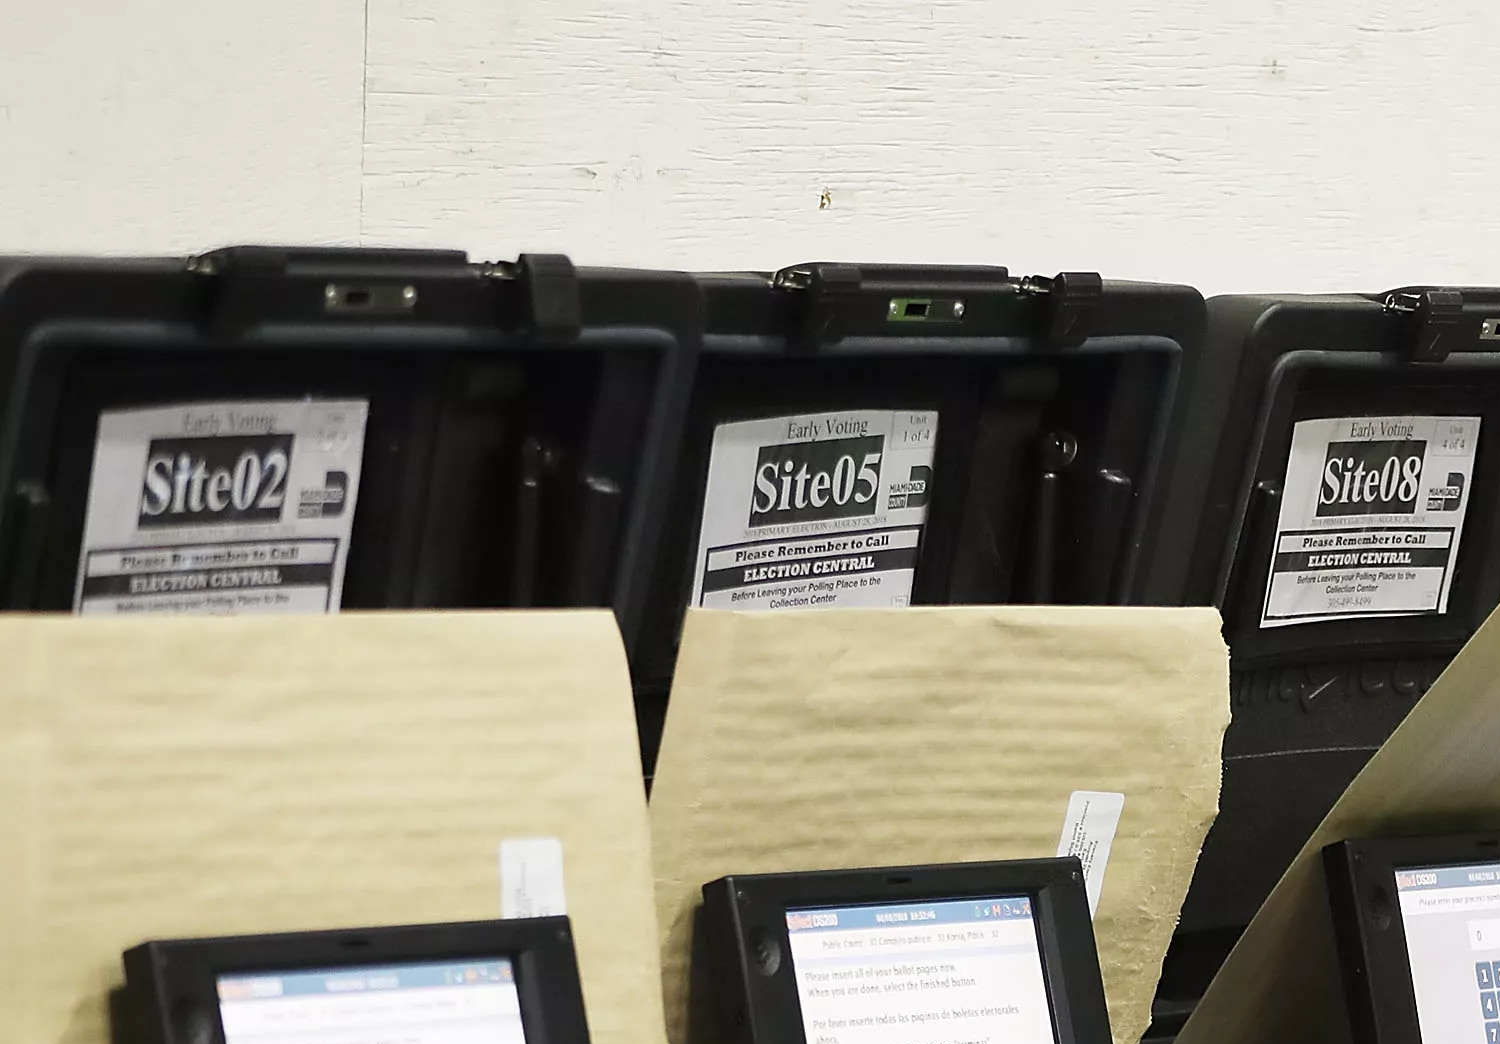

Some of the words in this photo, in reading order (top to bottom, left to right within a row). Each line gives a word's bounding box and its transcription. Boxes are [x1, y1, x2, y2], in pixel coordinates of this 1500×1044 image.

[787, 422, 820, 442] Early
[826, 418, 868, 436] Voting
[911, 429, 922, 442] of
[923, 429, 930, 441] 4
[1350, 422, 1375, 441] Early
[1380, 421, 1414, 440] Voting
[143, 453, 288, 515] Site02
[752, 453, 881, 515] Site05
[890, 482, 924, 493] MIAMI-DADE
[1320, 456, 1421, 505] Site08
[1303, 537, 1333, 548] Please
[1335, 535, 1389, 546] Remember
[1392, 534, 1402, 544] to
[1404, 534, 1426, 545] Call
[735, 548, 775, 563] Please
[777, 541, 847, 558] Remember
[850, 540, 862, 550] to
[865, 535, 890, 547] Call
[1308, 553, 1359, 567] ELECTION
[1360, 552, 1411, 564] CENTRAL
[744, 562, 810, 582] ELECTION
[813, 556, 875, 575] CENTRAL
[1297, 575, 1316, 584] Before
[1317, 574, 1340, 584] Leaving
[1378, 571, 1395, 580] Place
[1405, 571, 1416, 580] the
[731, 591, 756, 602] Before
[757, 586, 787, 599] Leaving
[788, 585, 806, 596] your
[808, 580, 834, 593] Polling
[836, 579, 858, 589] Place
[860, 579, 868, 587] to
[869, 577, 881, 586] the
[1326, 585, 1355, 594] Collection
[1357, 584, 1378, 592] Center
[770, 597, 808, 608] Collection
[810, 594, 837, 605] Center
[805, 972, 830, 983] Please
[1481, 970, 1488, 983] 1
[1486, 999, 1493, 1012] 4
[1490, 1029, 1497, 1042] 7
